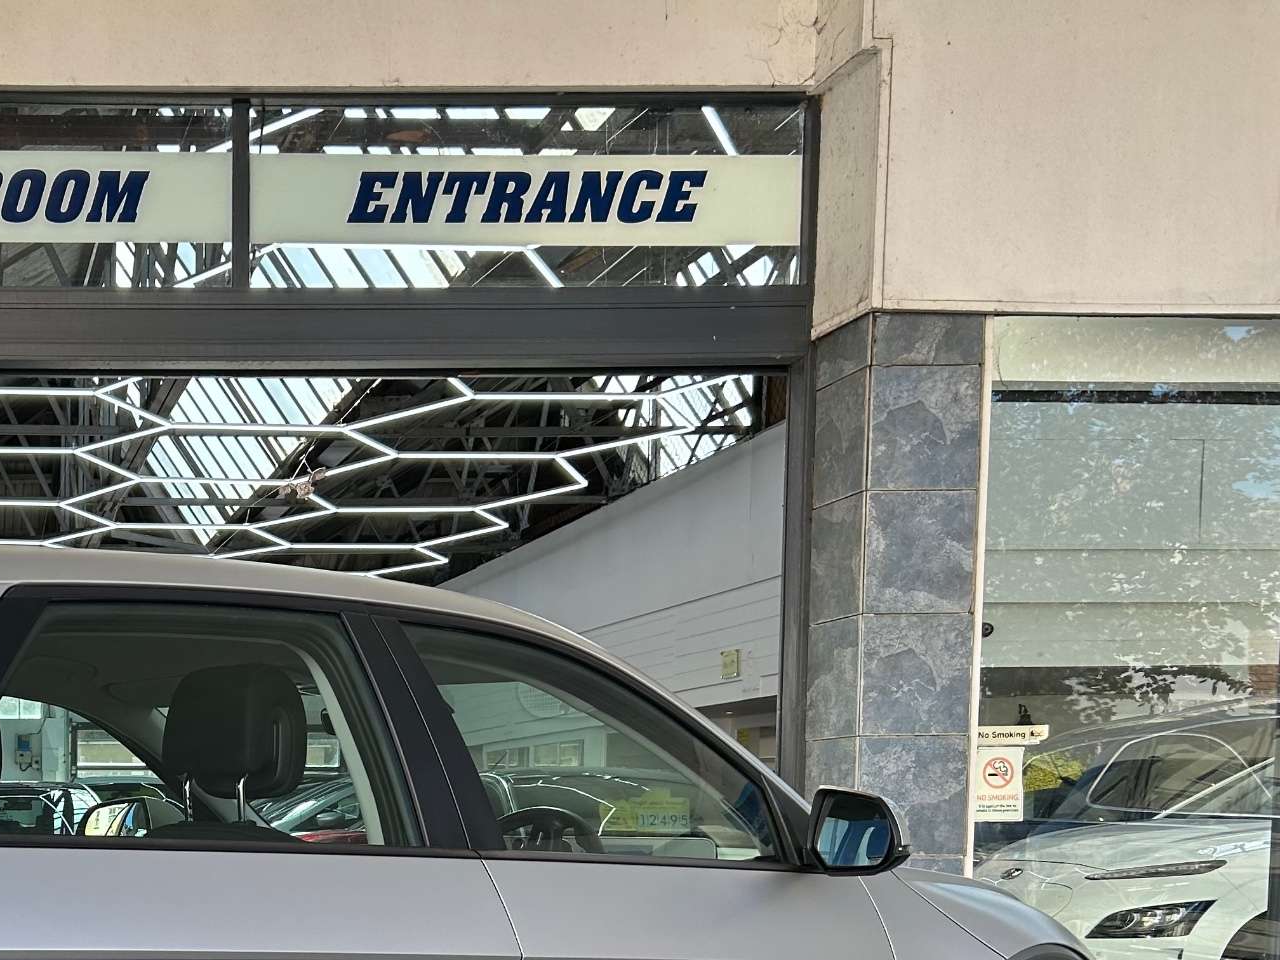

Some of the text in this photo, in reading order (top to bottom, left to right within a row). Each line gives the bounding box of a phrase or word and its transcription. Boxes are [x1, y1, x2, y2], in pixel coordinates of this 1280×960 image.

[347, 170, 707, 223] ENTRANCE
[978, 731, 1025, 739] No Smoking
